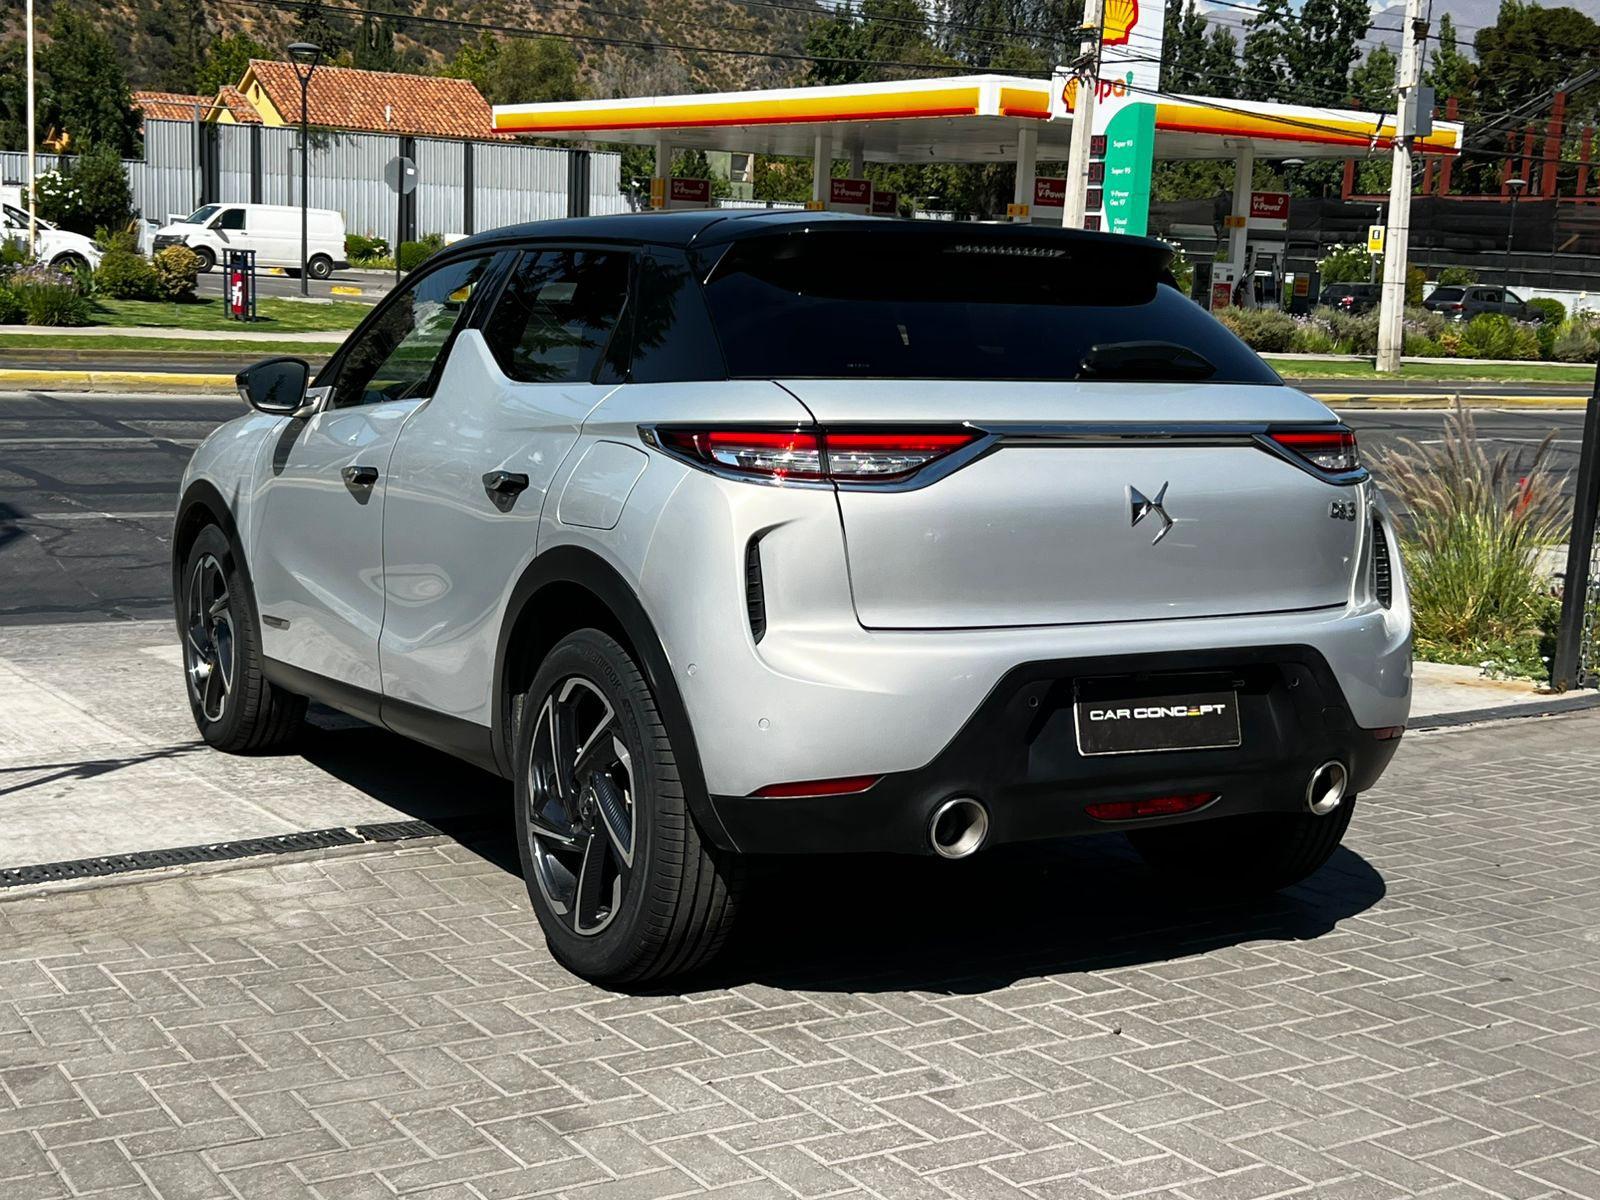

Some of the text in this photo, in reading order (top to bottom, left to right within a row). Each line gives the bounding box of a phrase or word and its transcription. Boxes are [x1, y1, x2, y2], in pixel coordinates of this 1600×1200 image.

[1037, 188, 1065, 198] V-Powe
[1253, 201, 1282, 211] V-Power
[1089, 704, 1226, 721] CAR CONCEPT
